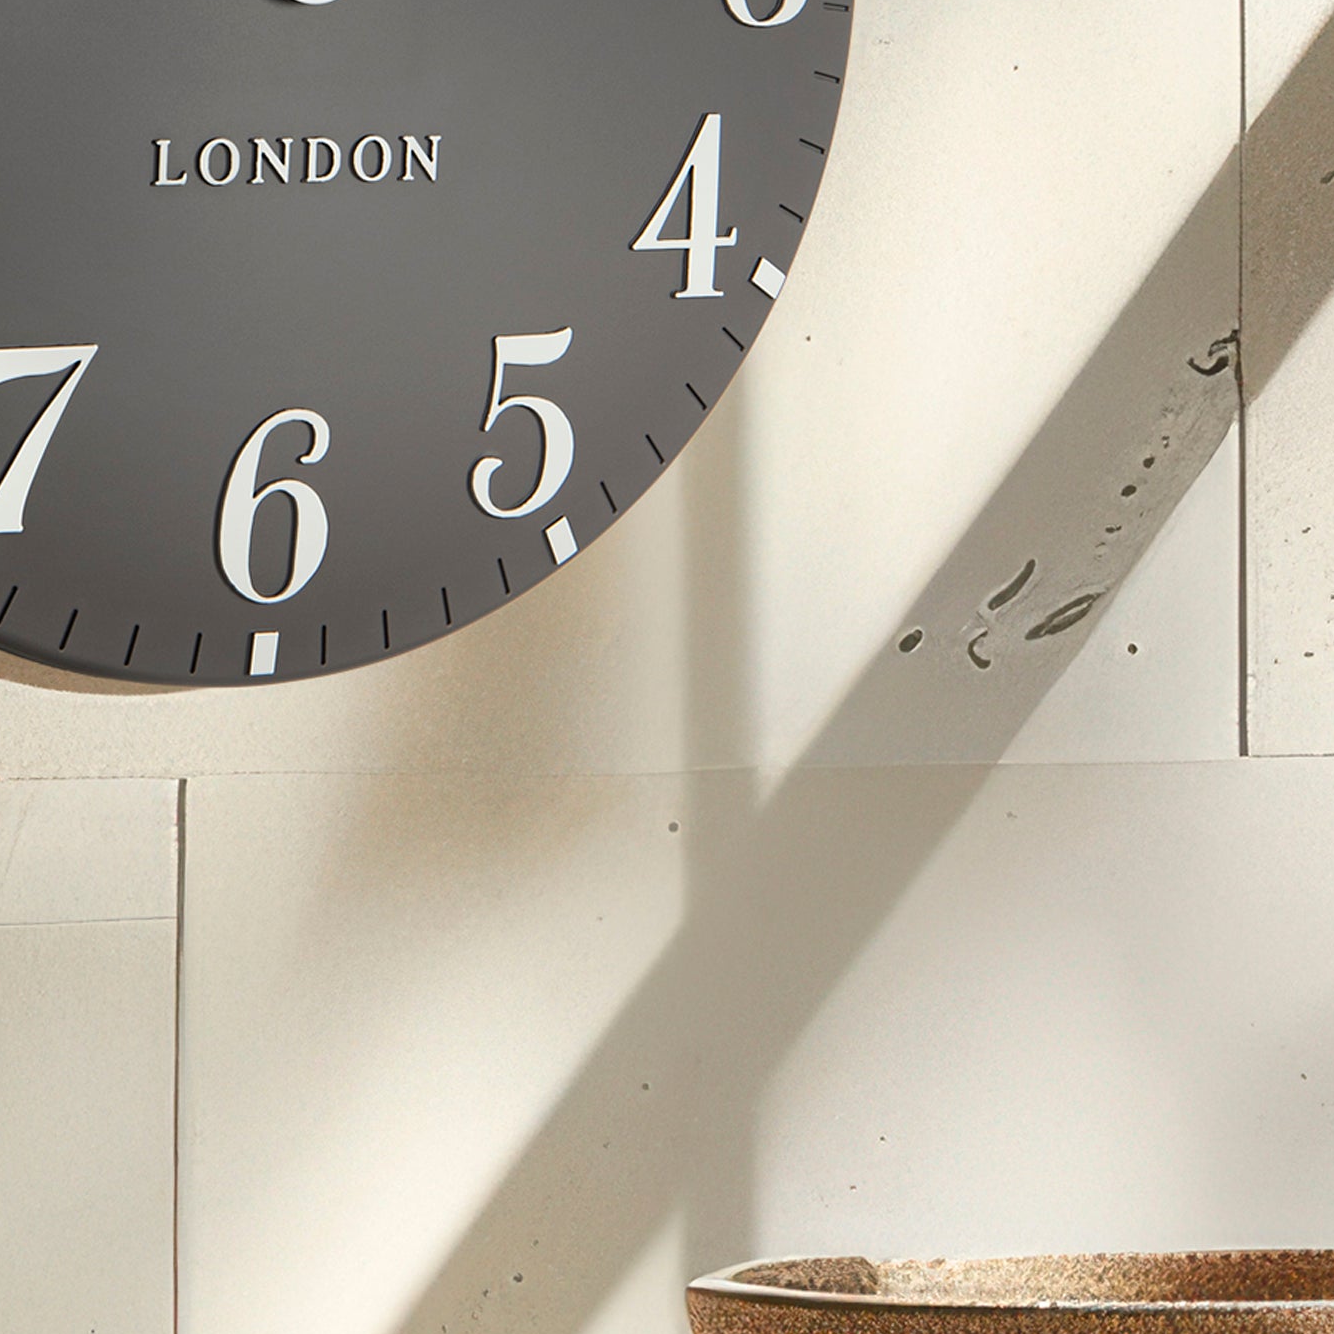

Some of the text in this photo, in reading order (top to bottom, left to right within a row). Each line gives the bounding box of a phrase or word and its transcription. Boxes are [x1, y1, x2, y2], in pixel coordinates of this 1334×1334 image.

[153, 134, 443, 187] LONDON
[632, 113, 738, 299] 4
[219, 408, 331, 604] 6
[472, 326, 575, 519] 5
